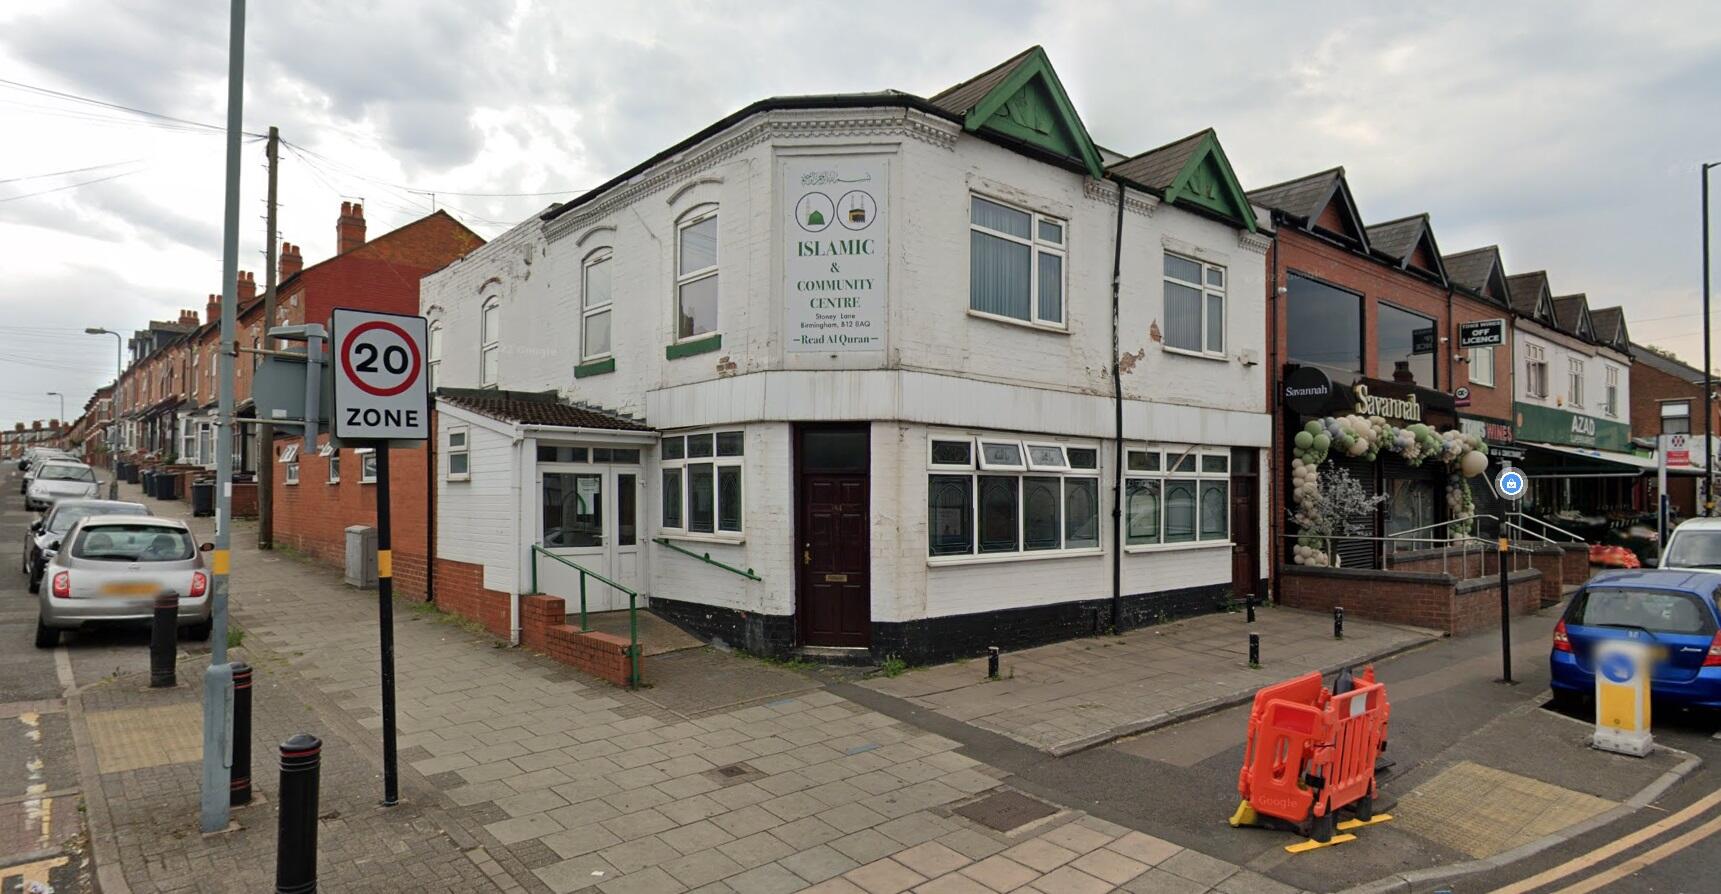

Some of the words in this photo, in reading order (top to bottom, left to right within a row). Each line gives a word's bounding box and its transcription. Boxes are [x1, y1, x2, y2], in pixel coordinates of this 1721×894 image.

[798, 239, 875, 256] ISLAMIC
[830, 262, 840, 273] &
[797, 279, 875, 291] COMMUNITY
[810, 297, 861, 309] CENTRE
[840, 312, 856, 320] Lane
[1471, 328, 1490, 337] OFF
[801, 335, 825, 344] Read
[839, 334, 870, 346] Quran
[1462, 335, 1500, 345] LICENCE
[355, 343, 409, 374] 20
[1286, 384, 1328, 397] Savannah
[1354, 384, 1421, 421] Savannah
[346, 408, 419, 427] ZONE
[1571, 415, 1596, 436] AZAD
